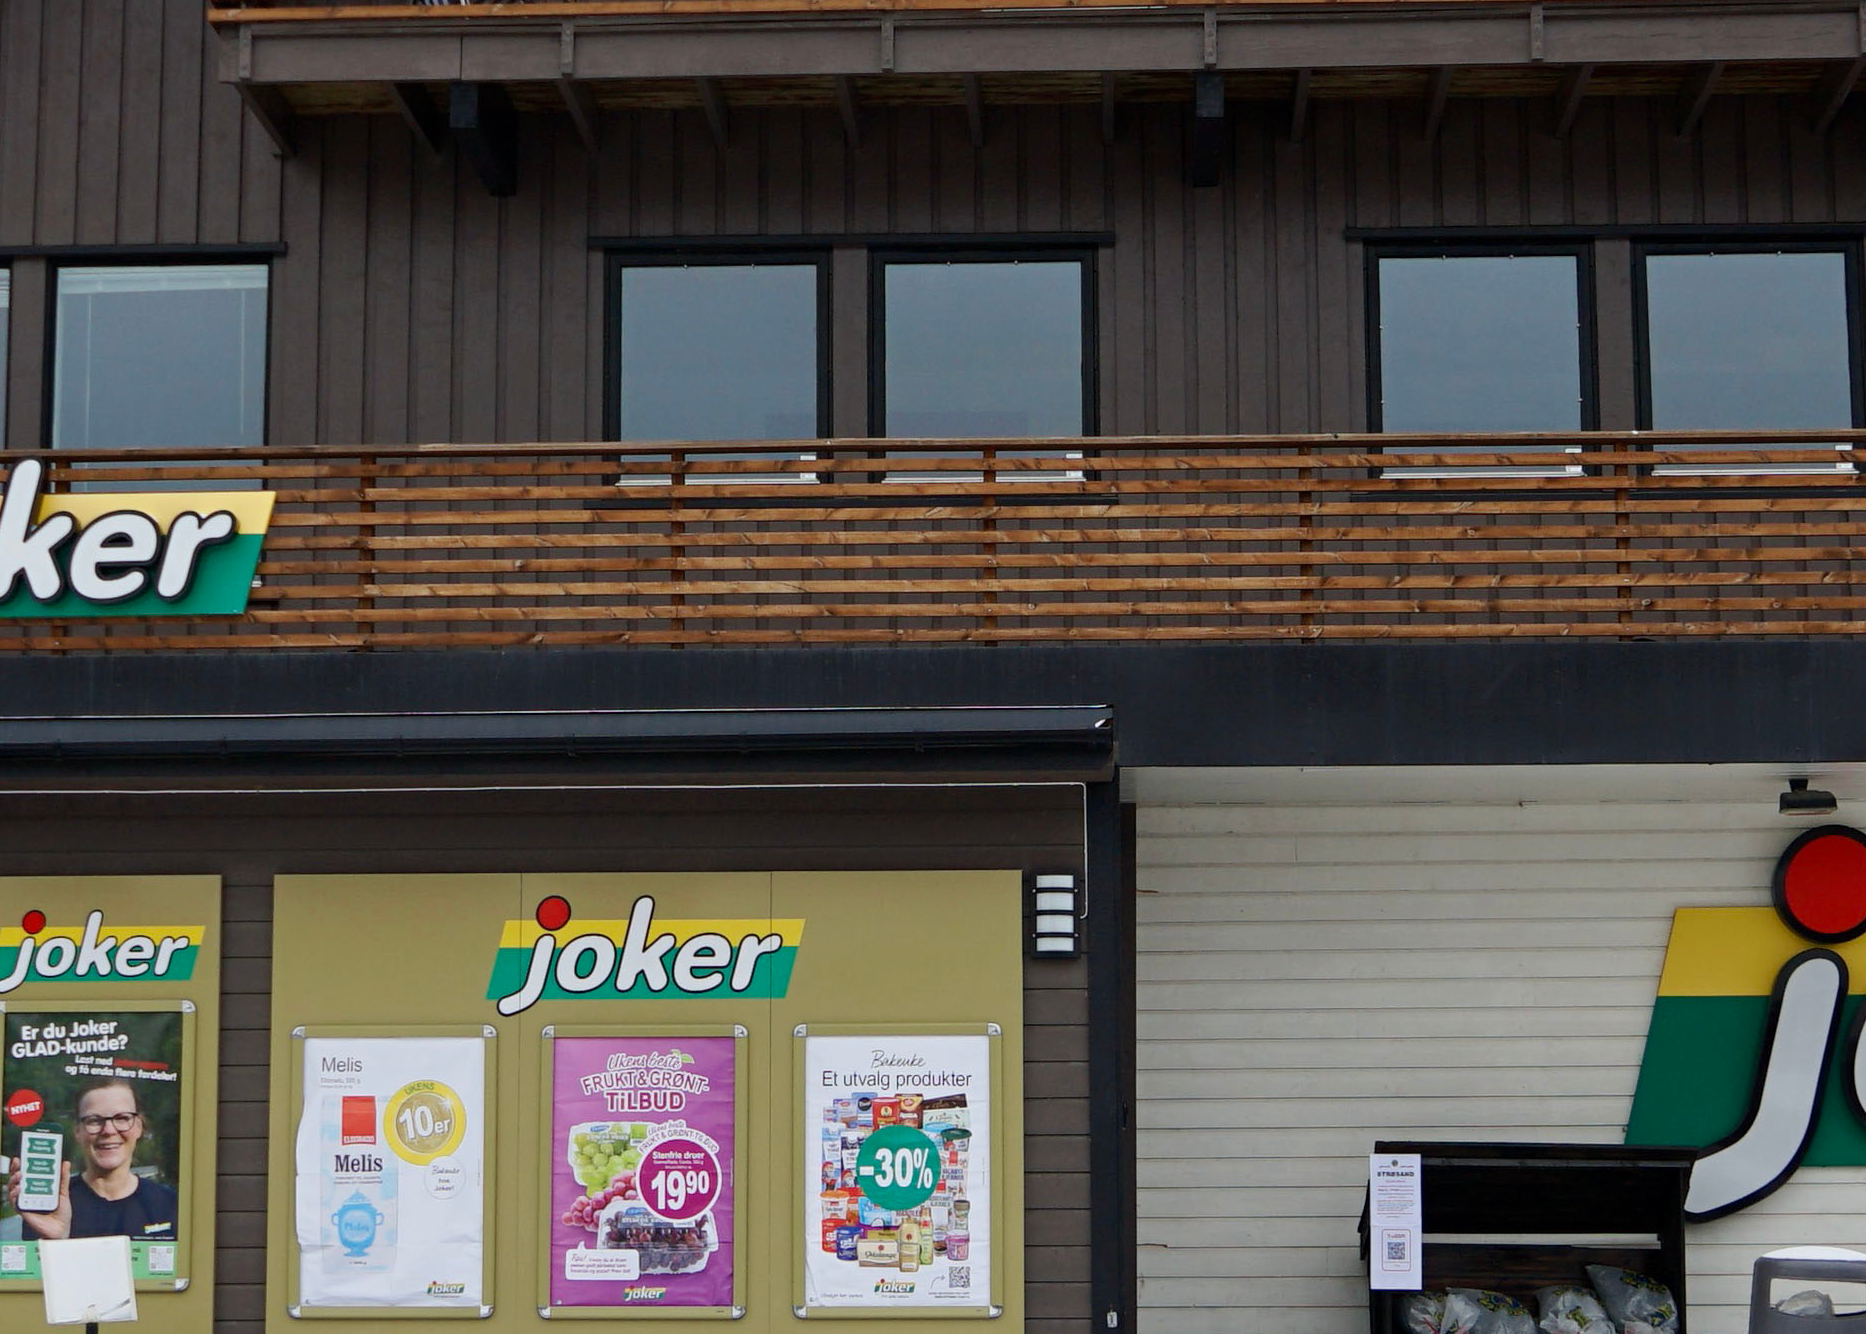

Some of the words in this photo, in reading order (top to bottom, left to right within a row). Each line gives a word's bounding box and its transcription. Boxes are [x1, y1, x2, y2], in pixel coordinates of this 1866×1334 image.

[497, 895, 783, 1017] joker
[21, 1025, 40, 1041] Er
[43, 1022, 66, 1038] du
[69, 1019, 118, 1038] Joker
[11, 1034, 129, 1058] GLAD-kunde?
[321, 1057, 363, 1073] Melis
[608, 1053, 647, 1069] Ukens
[648, 1052, 681, 1068] beste
[871, 1050, 927, 1068] Bakeuke
[404, 1083, 436, 1095] UKENS
[822, 1070, 838, 1087] Et
[843, 1070, 890, 1090] utvalg
[896, 1070, 972, 1089] produkter
[10, 1101, 41, 1116] NYHET
[334, 1154, 383, 1172] Melis
[859, 1147, 933, 1189] -30%
[625, 1285, 663, 1301] joker
[876, 1278, 914, 1293] joker
